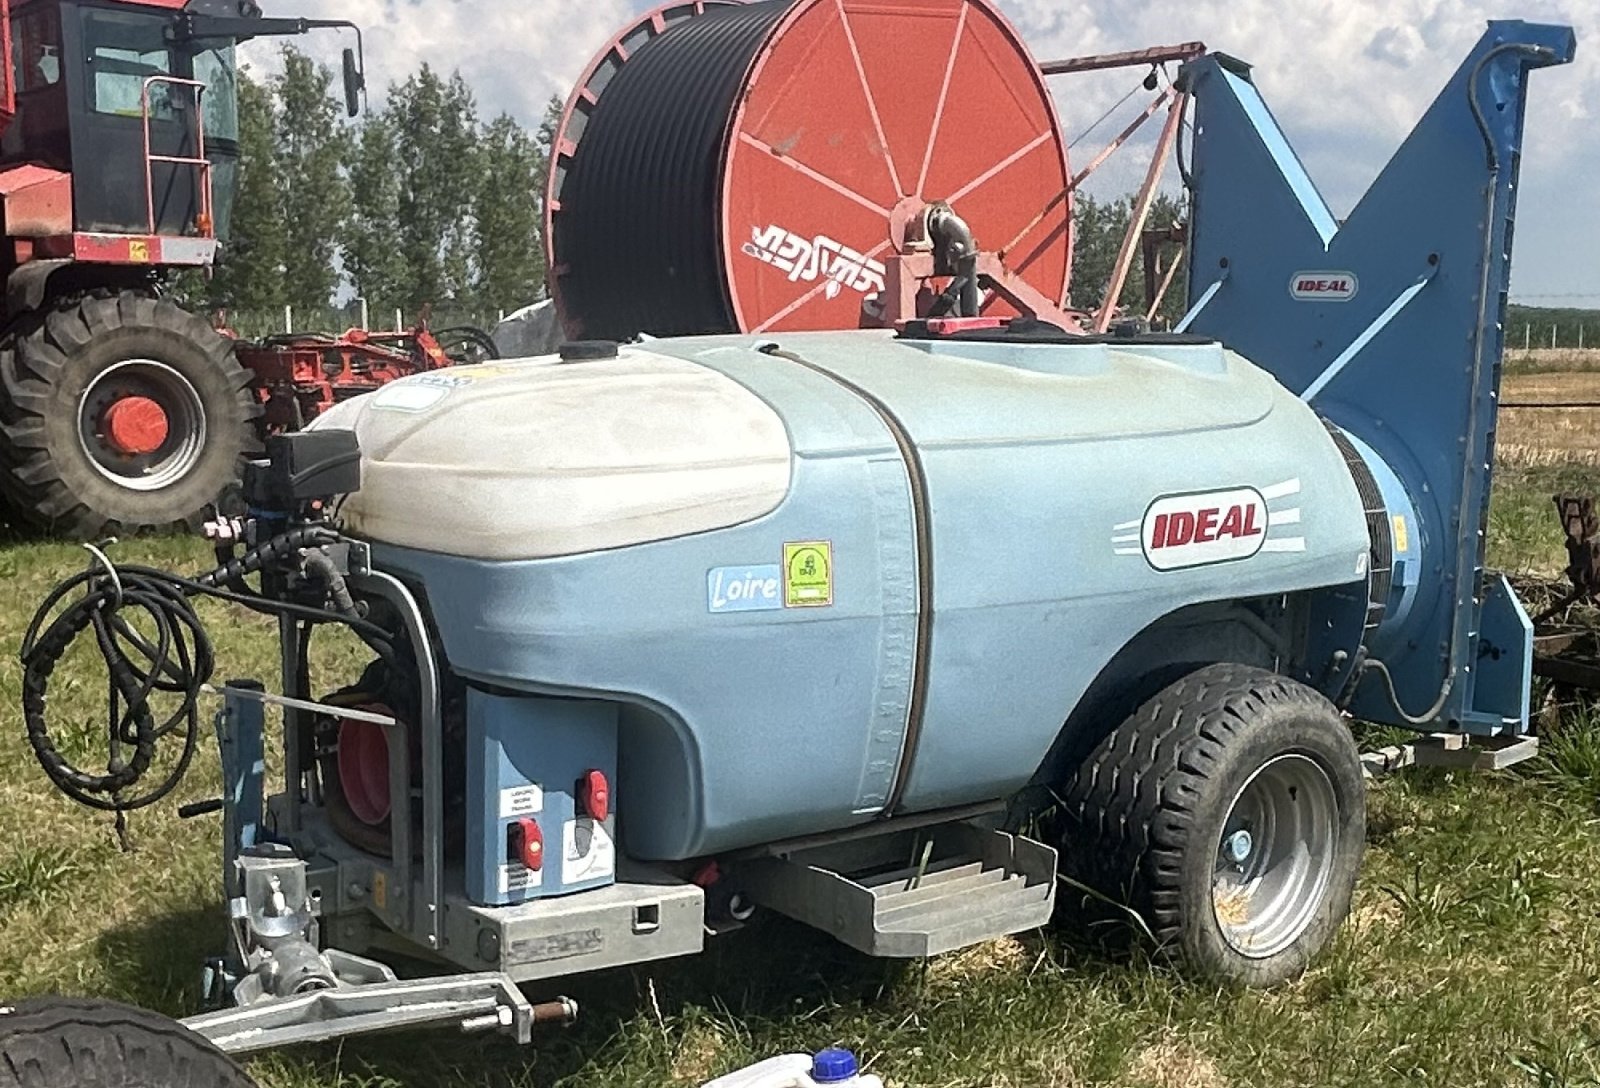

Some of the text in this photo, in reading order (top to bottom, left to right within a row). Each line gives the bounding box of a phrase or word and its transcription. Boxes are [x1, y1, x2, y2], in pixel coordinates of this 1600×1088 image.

[1296, 280, 1349, 292] IDEAL
[1152, 503, 1262, 549] IDEAL
[713, 571, 777, 608] Loire
